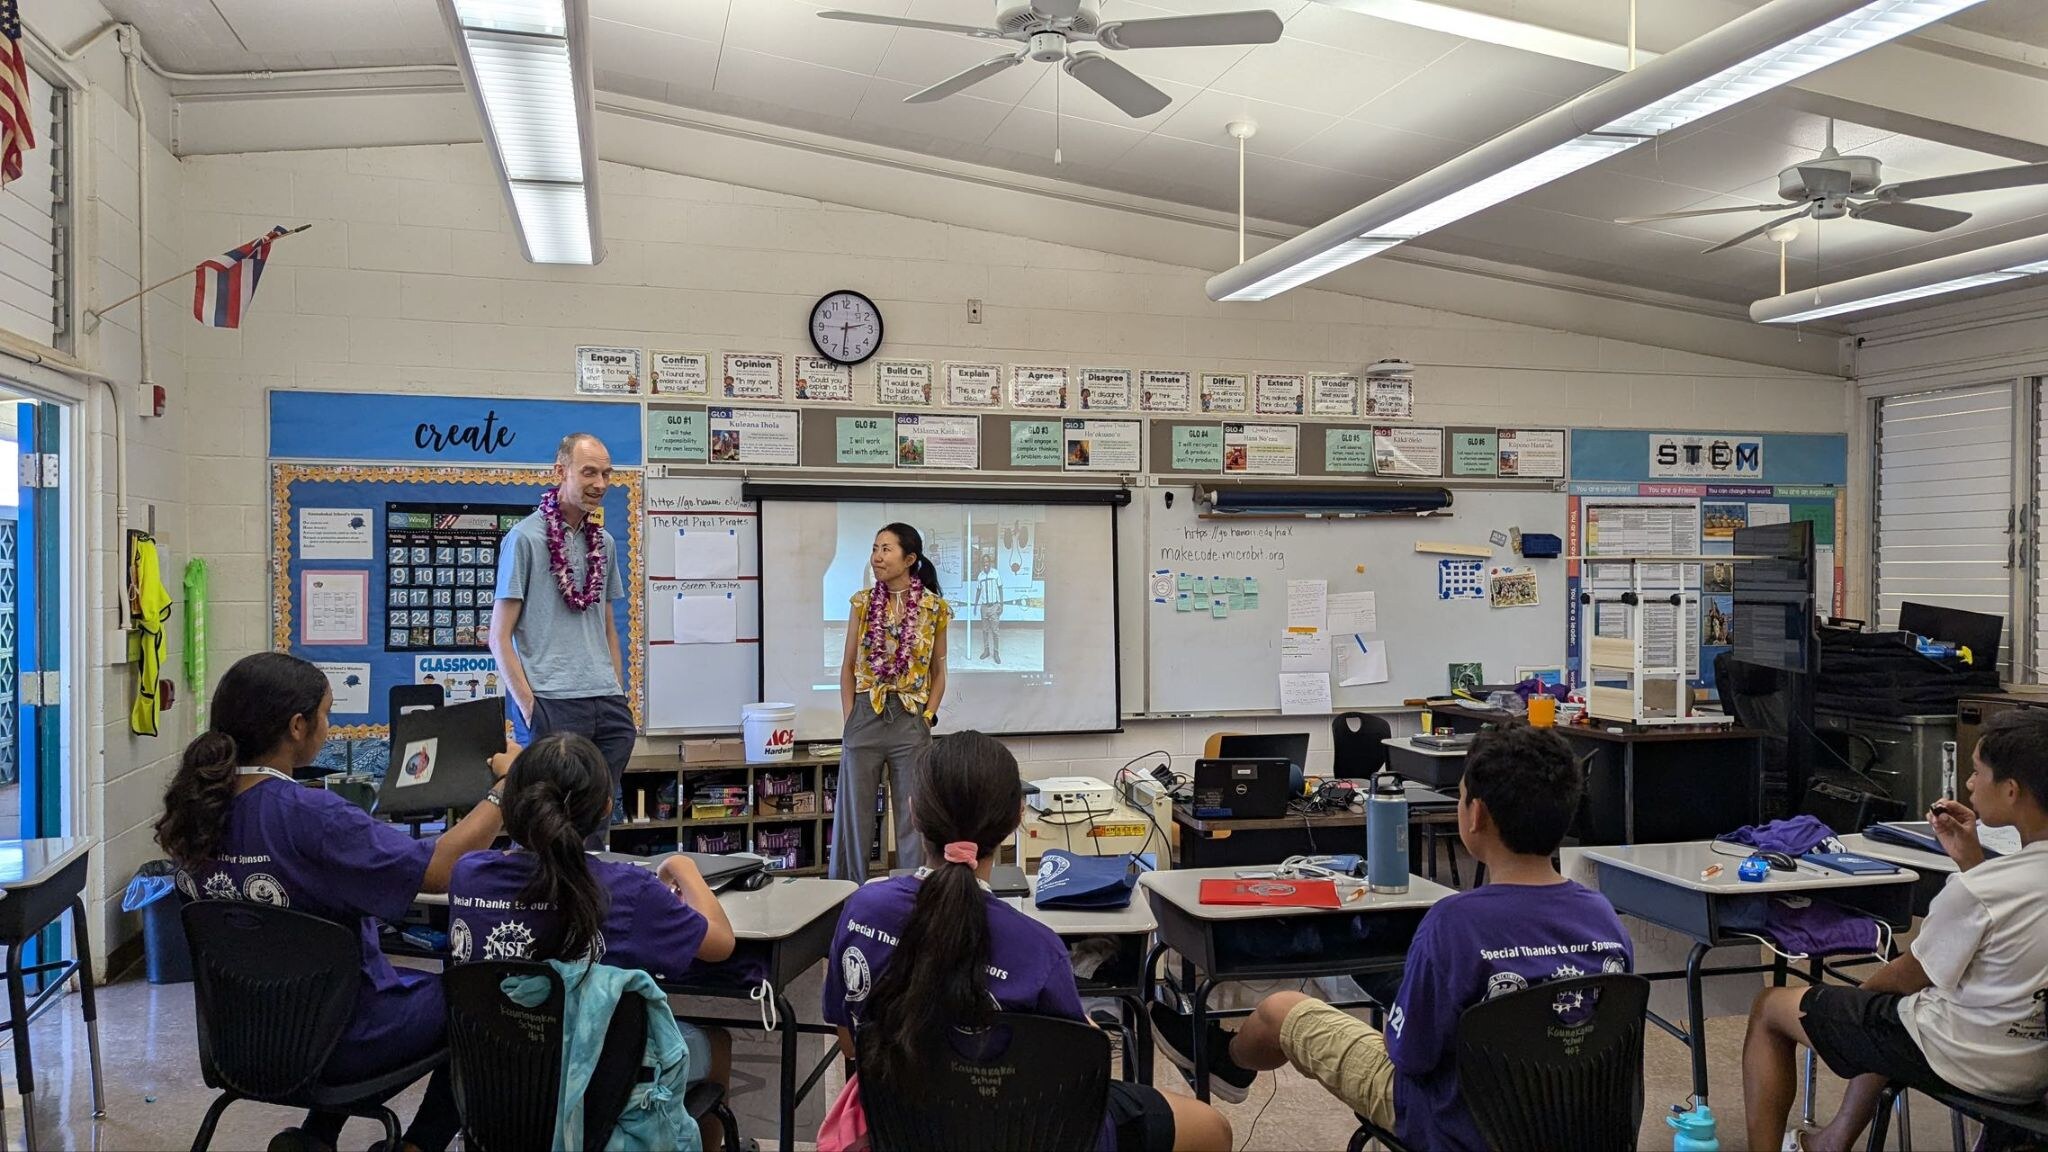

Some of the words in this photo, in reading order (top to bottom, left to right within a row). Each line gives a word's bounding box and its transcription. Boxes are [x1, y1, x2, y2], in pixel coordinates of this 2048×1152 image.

[832, 302, 839, 311] 11
[842, 300, 850, 310] 12
[822, 310, 832, 319] 10
[591, 354, 626, 364] Engage
[662, 356, 698, 364] Confirm
[735, 360, 772, 370] Opinion
[810, 362, 838, 371] Clarify
[887, 367, 908, 375] Build
[910, 368, 922, 376] On
[959, 370, 990, 379] Explain
[1028, 372, 1054, 381] Agree
[1088, 374, 1124, 383] Disagree
[1150, 376, 1180, 384] Restate
[668, 416, 682, 424] GLO
[684, 416, 692, 424] #1
[854, 420, 868, 429] GLO
[869, 420, 877, 429] #2
[415, 410, 516, 454] create
[1028, 426, 1039, 434] GLO
[1041, 426, 1048, 435] #3
[1657, 442, 1759, 470] STEM
[408, 516, 429, 526] Windy
[652, 517, 670, 527] The
[672, 517, 688, 527] Red
[718, 517, 749, 526] Pirates
[392, 548, 404, 564] 2
[414, 548, 425, 562] 3
[439, 548, 451, 562] 4
[461, 548, 471, 563] 5
[481, 549, 491, 563] 6
[394, 569, 405, 584] 9
[418, 570, 433, 583] 10
[440, 570, 454, 583] 11
[460, 570, 474, 583] 12
[479, 571, 494, 583] 13
[392, 591, 408, 604] 16
[412, 591, 426, 604] 17
[436, 591, 450, 604] 18
[458, 592, 472, 604] 19
[479, 592, 494, 604] 20
[390, 612, 408, 625] 23
[412, 612, 428, 624] 24
[435, 612, 450, 624] 25
[458, 613, 472, 625] 26
[392, 631, 406, 643] 30
[765, 729, 794, 746] ACE
[765, 747, 793, 756] Hardwa
[474, 897, 511, 909] Thanks
[530, 902, 549, 910] our
[847, 919, 875, 938] Special
[1480, 946, 1519, 960] Special
[1519, 945, 1557, 957] Thanks
[1558, 944, 1568, 954] to
[1570, 944, 1589, 952] our
